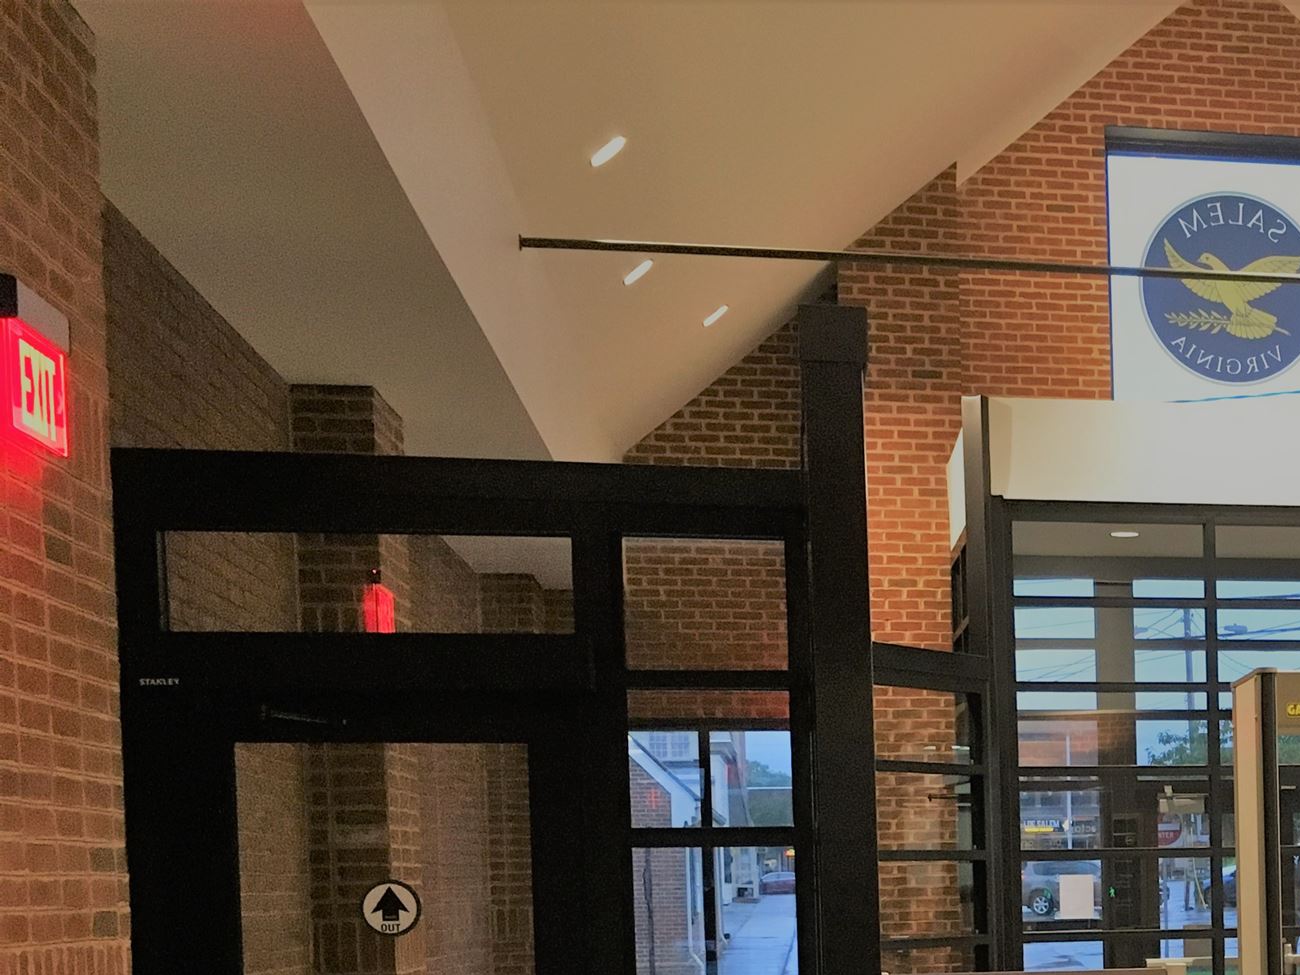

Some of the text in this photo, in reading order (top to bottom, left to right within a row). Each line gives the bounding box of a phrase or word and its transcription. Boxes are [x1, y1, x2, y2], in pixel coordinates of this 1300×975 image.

[18, 338, 57, 443] EXIT
[138, 678, 180, 687] STANLEY
[1157, 831, 1175, 839] NTER
[380, 923, 401, 933] OUT
